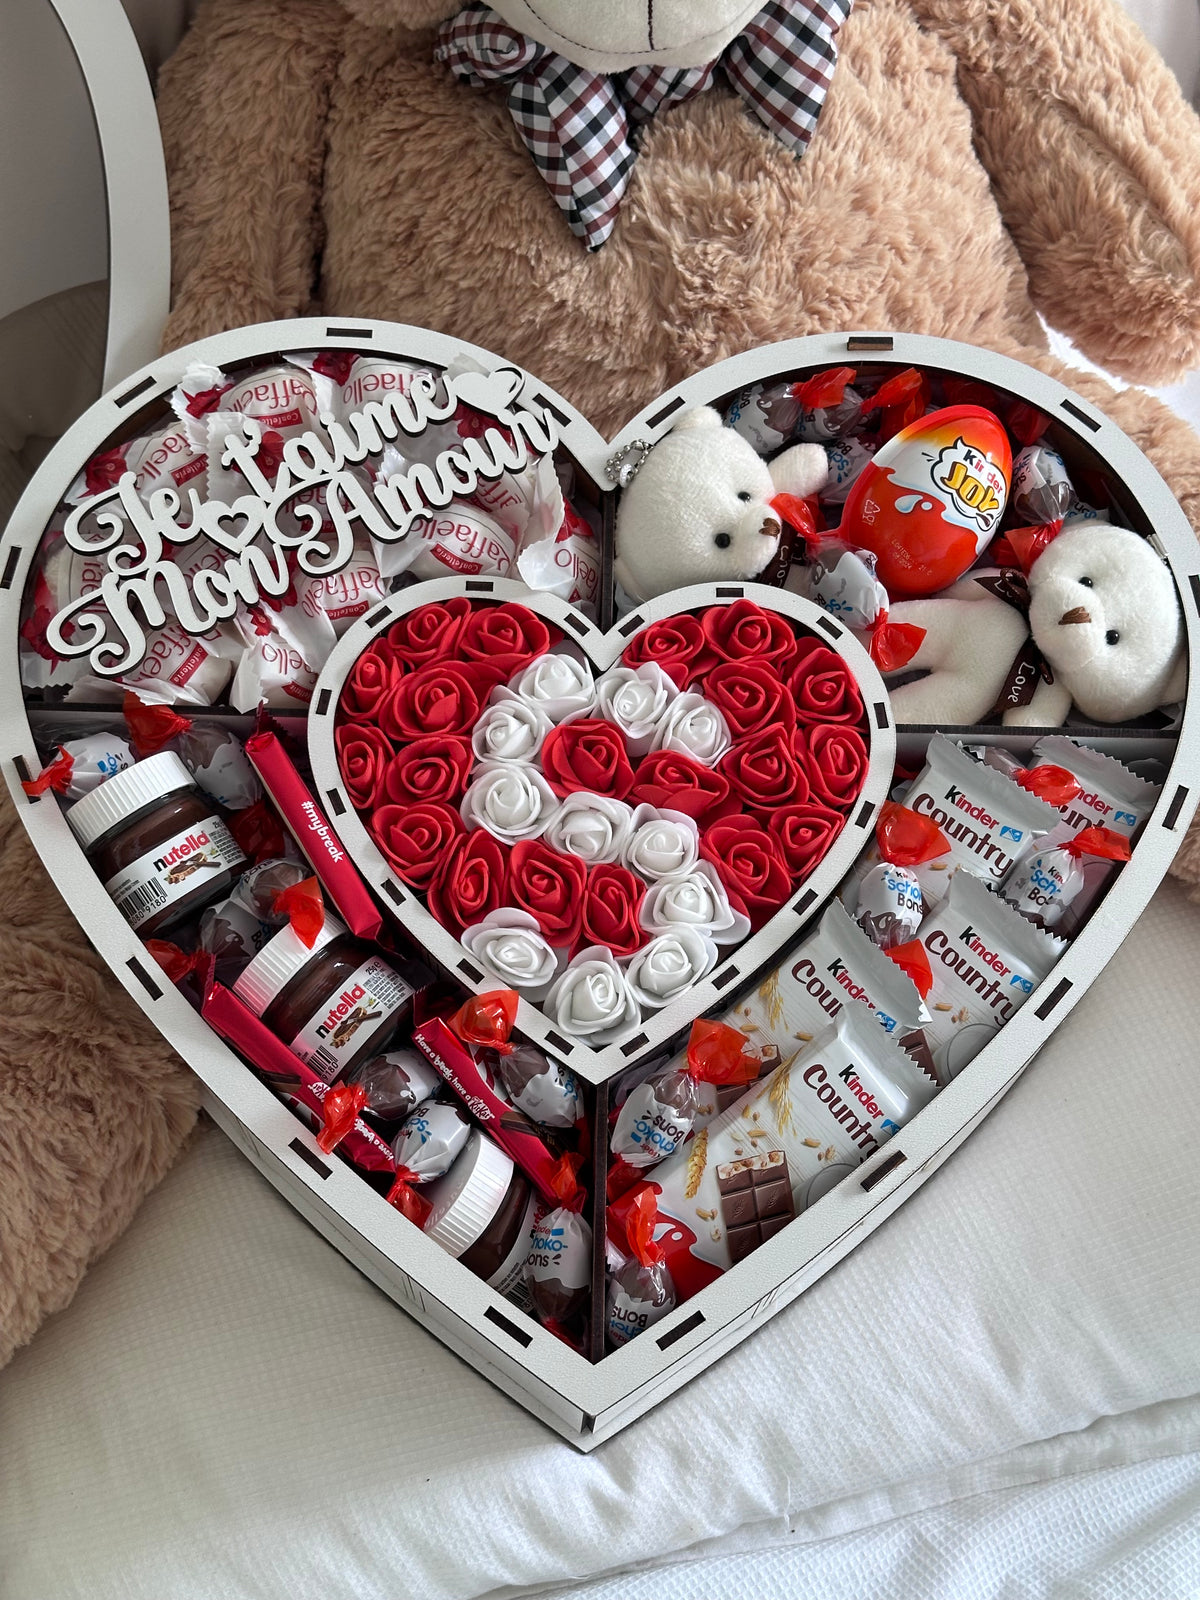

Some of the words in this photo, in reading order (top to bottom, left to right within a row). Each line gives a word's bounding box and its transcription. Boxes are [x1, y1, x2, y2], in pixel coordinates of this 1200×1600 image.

[940, 461, 1000, 513] JOY
[46, 542, 289, 675] Mon
[263, 408, 559, 574] Amour
[1007, 661, 1036, 703] Love
[153, 829, 210, 873] nutella
[301, 800, 344, 863] #mybreak
[912, 793, 1013, 878] Country
[145, 894, 167, 913] 9180
[315, 983, 366, 1039] nutella
[321, 1059, 339, 1082] 9180
[413, 1033, 434, 1054] Have
[429, 1051, 437, 1059] a
[450, 1077, 470, 1096] have
[464, 1094, 472, 1102] a
[652, 1114, 685, 1143] Bons
[527, 1253, 550, 1267] ons
